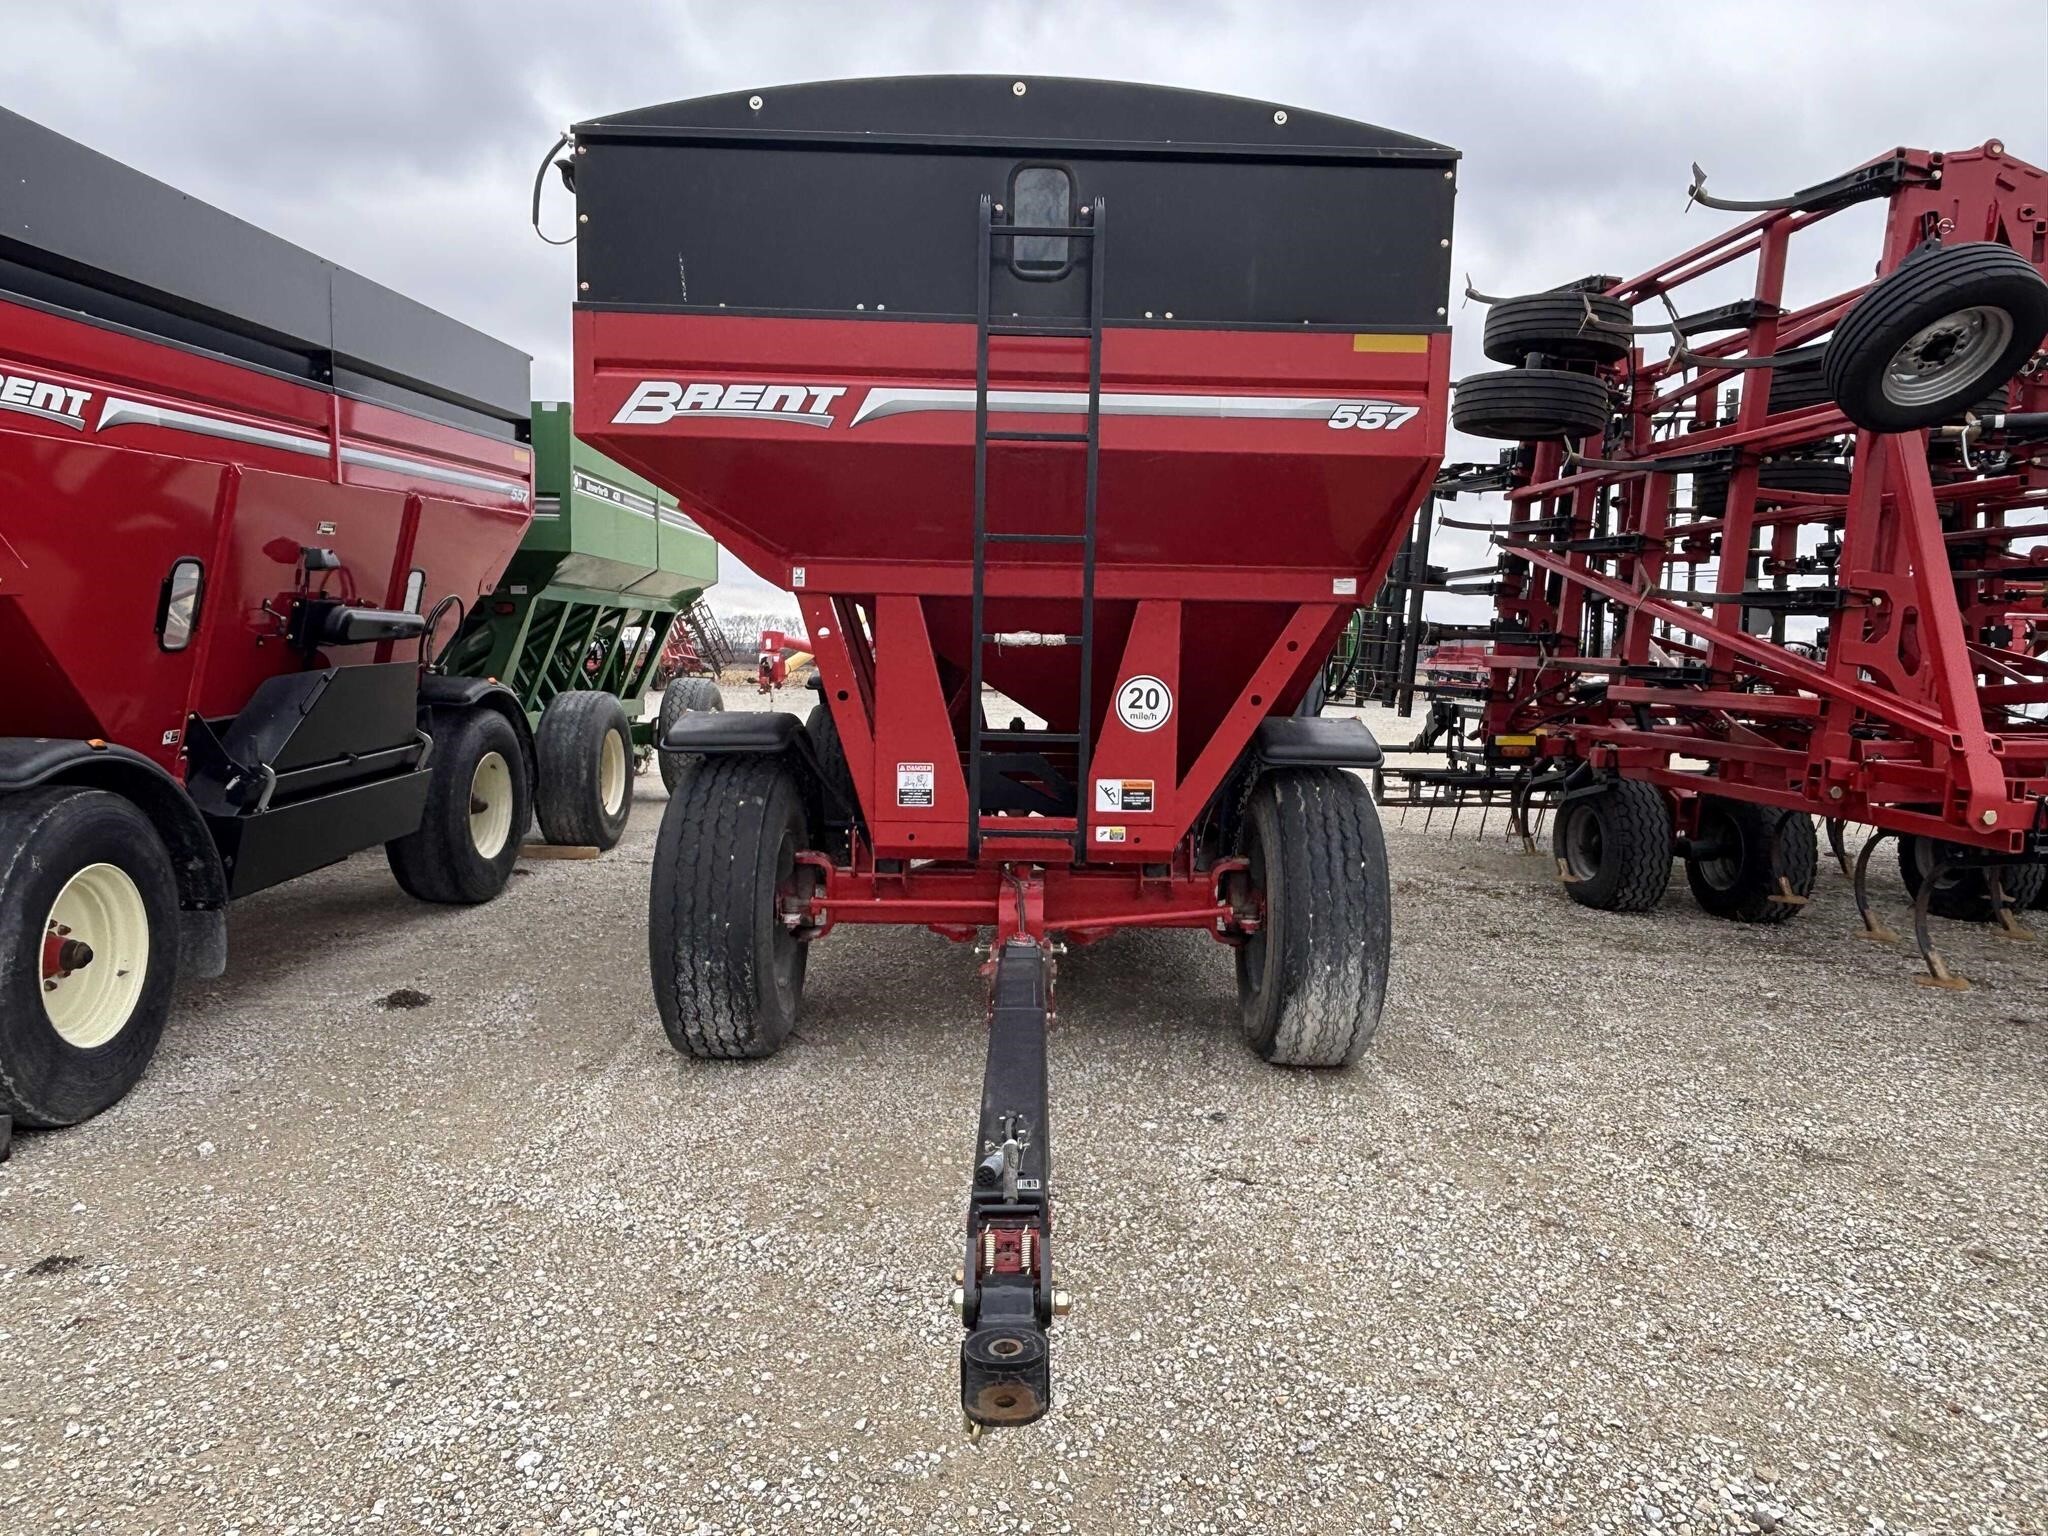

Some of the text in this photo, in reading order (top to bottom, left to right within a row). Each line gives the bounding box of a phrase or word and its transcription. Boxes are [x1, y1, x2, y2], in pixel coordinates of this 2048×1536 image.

[0, 374, 92, 417] ENT
[610, 381, 848, 424] BRENT
[1327, 404, 1421, 430] 557
[510, 487, 529, 503] 557
[1128, 687, 1160, 710] 20
